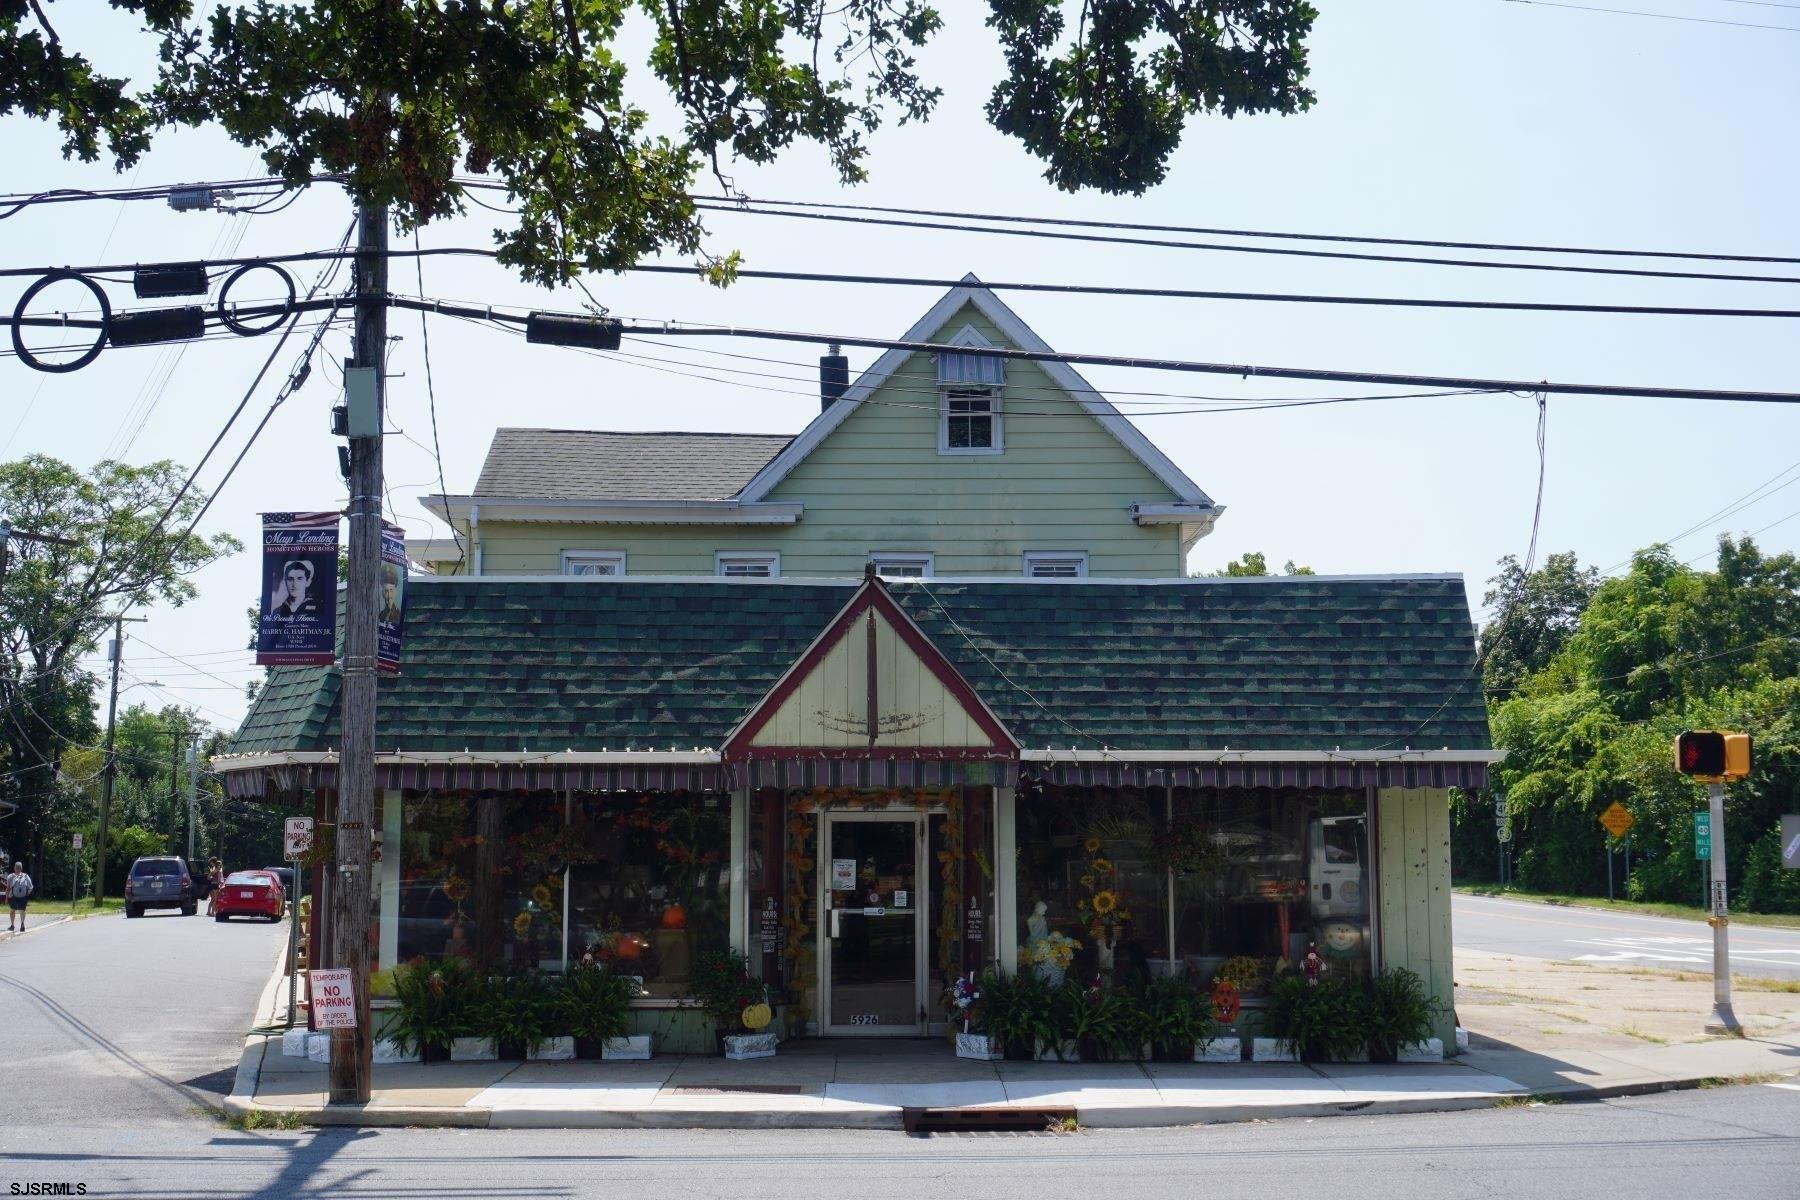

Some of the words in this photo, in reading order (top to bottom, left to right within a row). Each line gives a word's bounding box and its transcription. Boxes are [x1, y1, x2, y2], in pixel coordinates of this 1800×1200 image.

[266, 531, 294, 546] Mays
[296, 530, 336, 546] Landing
[288, 832, 311, 840] PARKING
[1699, 848, 1708, 856] 47
[313, 974, 348, 982] TEMPORARY
[324, 986, 340, 996] NO
[315, 997, 352, 1008] PARKING
[852, 1016, 878, 1024] 5926
